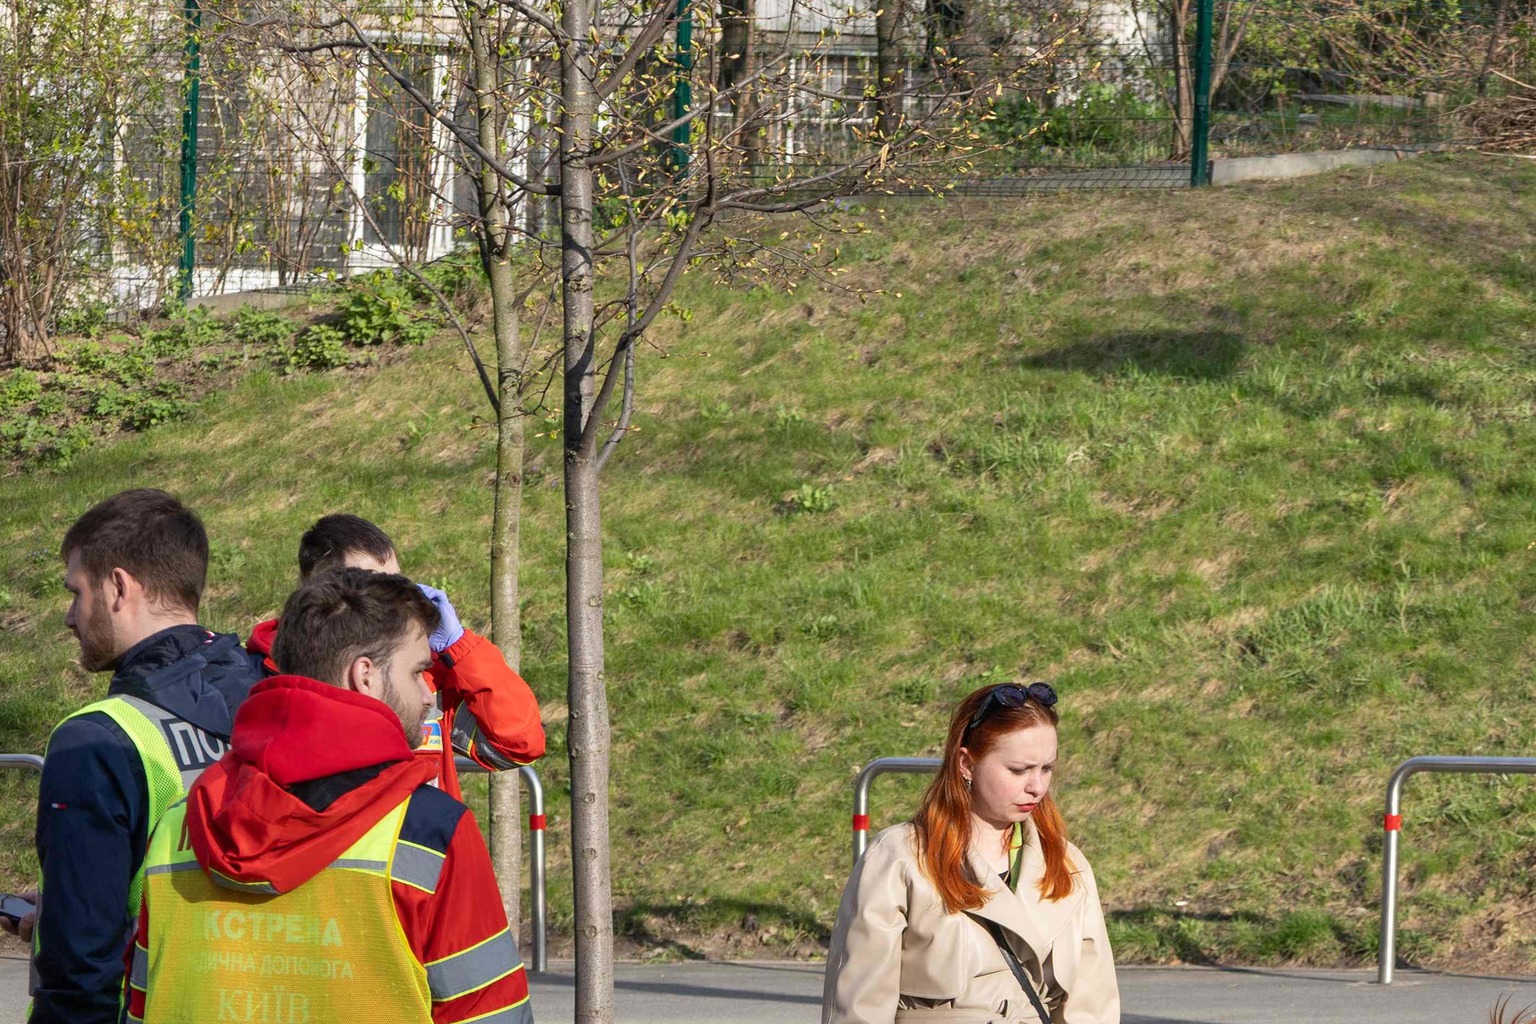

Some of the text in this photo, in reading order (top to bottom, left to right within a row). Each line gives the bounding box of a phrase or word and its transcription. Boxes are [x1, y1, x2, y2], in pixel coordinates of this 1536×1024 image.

[168, 722, 232, 766] ПО
[194, 909, 343, 948] КСТРЕНА
[217, 985, 311, 1024] КИЇВ
